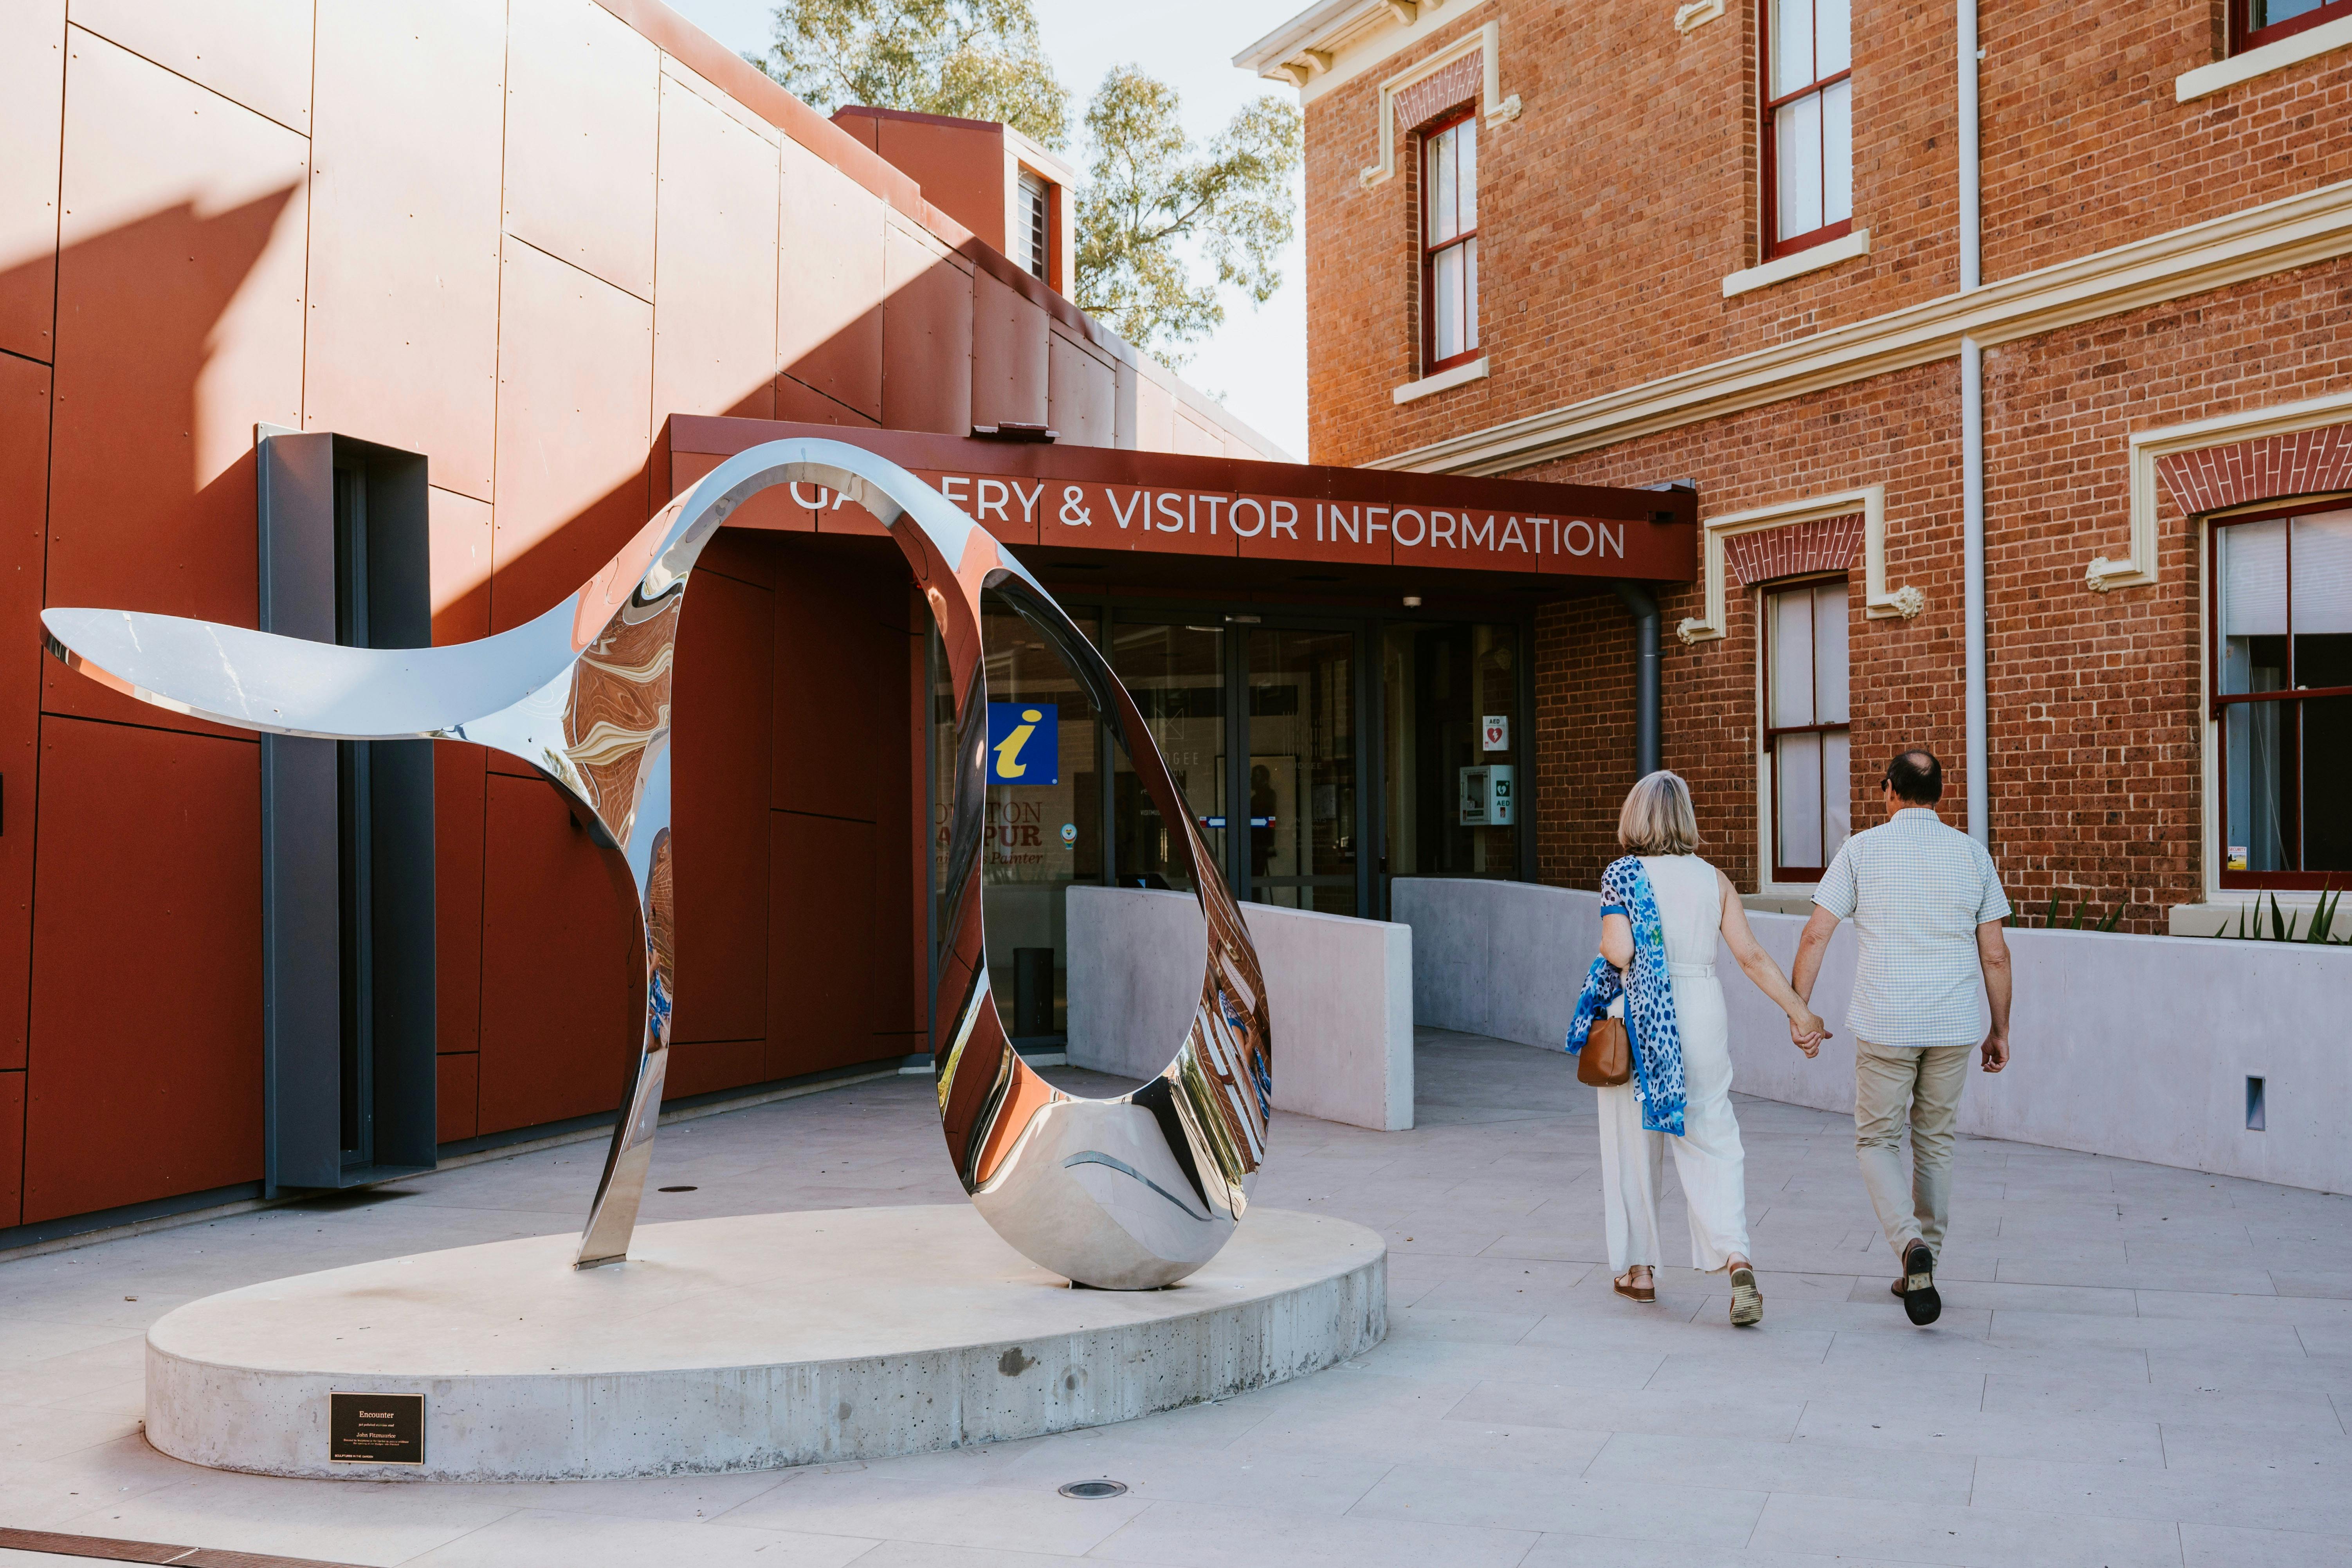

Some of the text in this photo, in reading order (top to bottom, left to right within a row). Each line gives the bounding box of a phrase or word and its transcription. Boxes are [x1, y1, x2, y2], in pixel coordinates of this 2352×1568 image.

[790, 474, 1624, 559] GERY & VISITOR INFORMATION
[989, 851, 1043, 865] Painter
